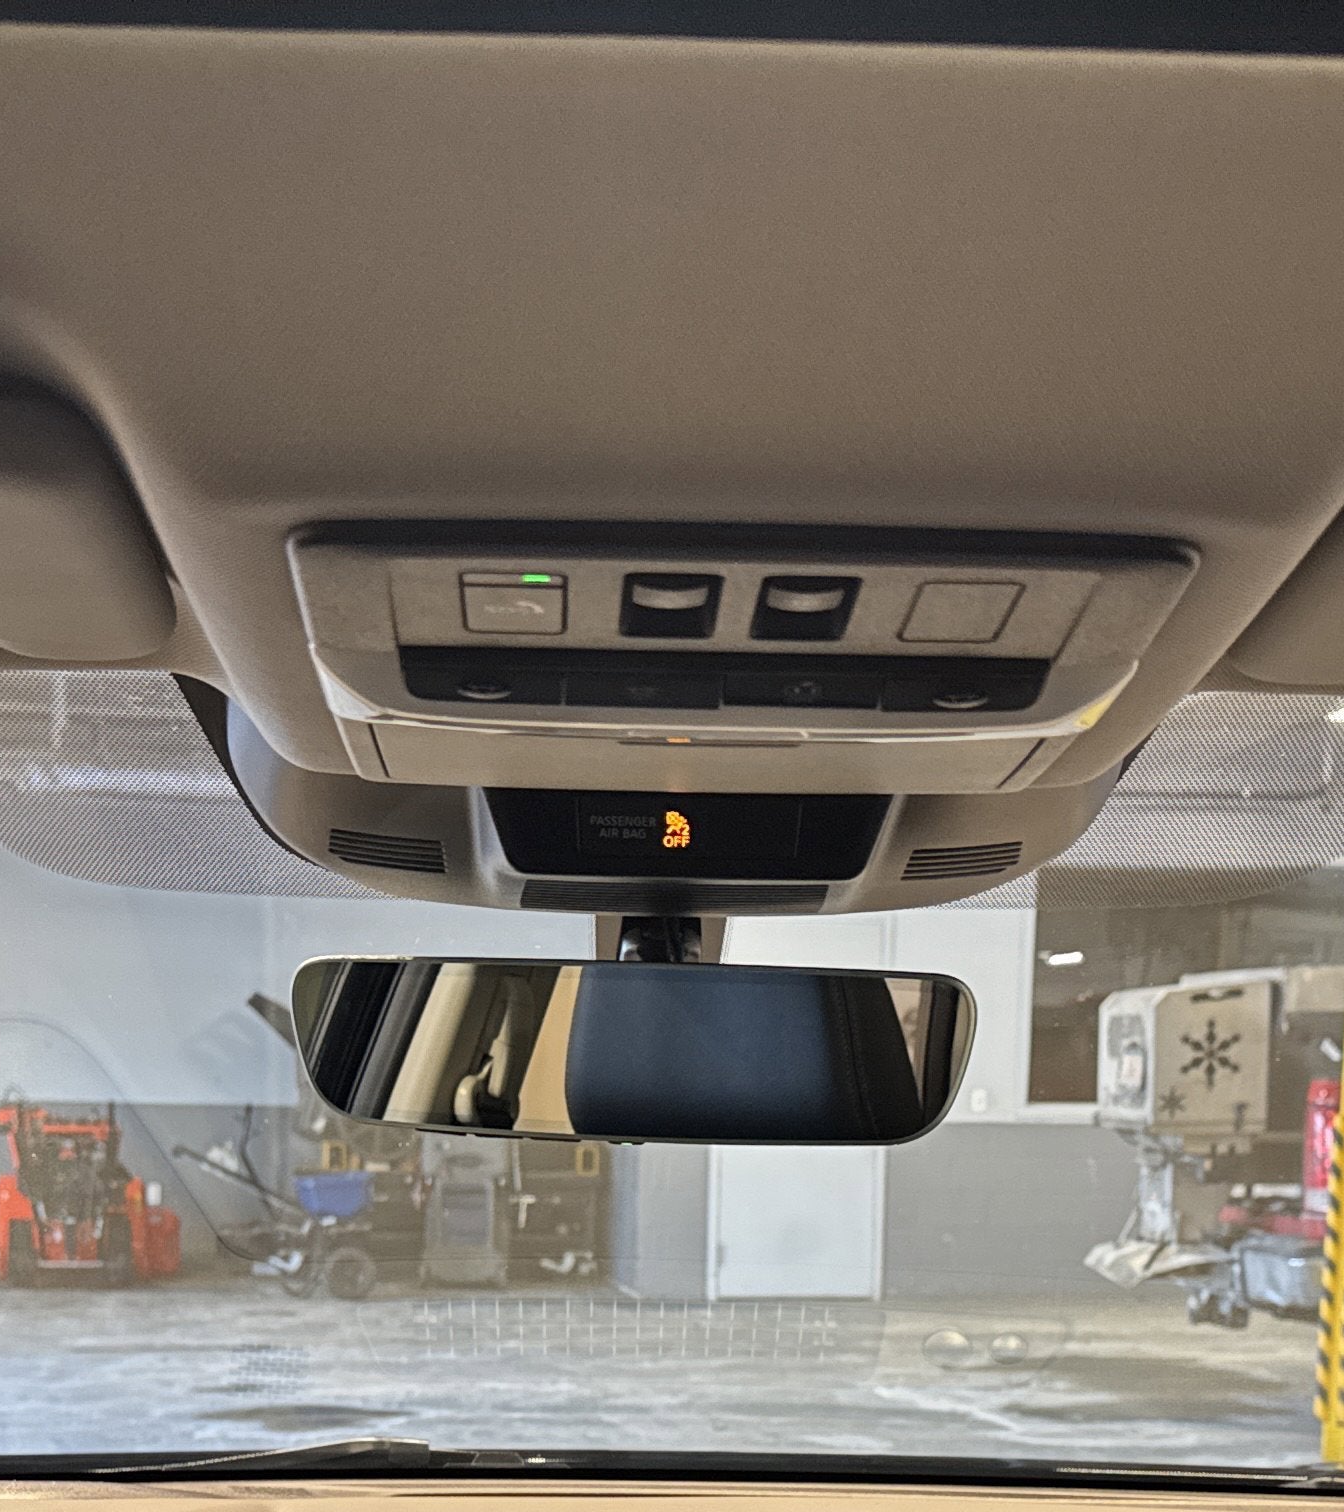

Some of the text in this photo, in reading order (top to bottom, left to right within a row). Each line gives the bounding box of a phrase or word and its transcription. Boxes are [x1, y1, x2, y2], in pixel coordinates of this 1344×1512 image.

[590, 815, 656, 828] PASSENGER
[599, 827, 647, 839] AIR BAG
[662, 835, 691, 848] OFF
